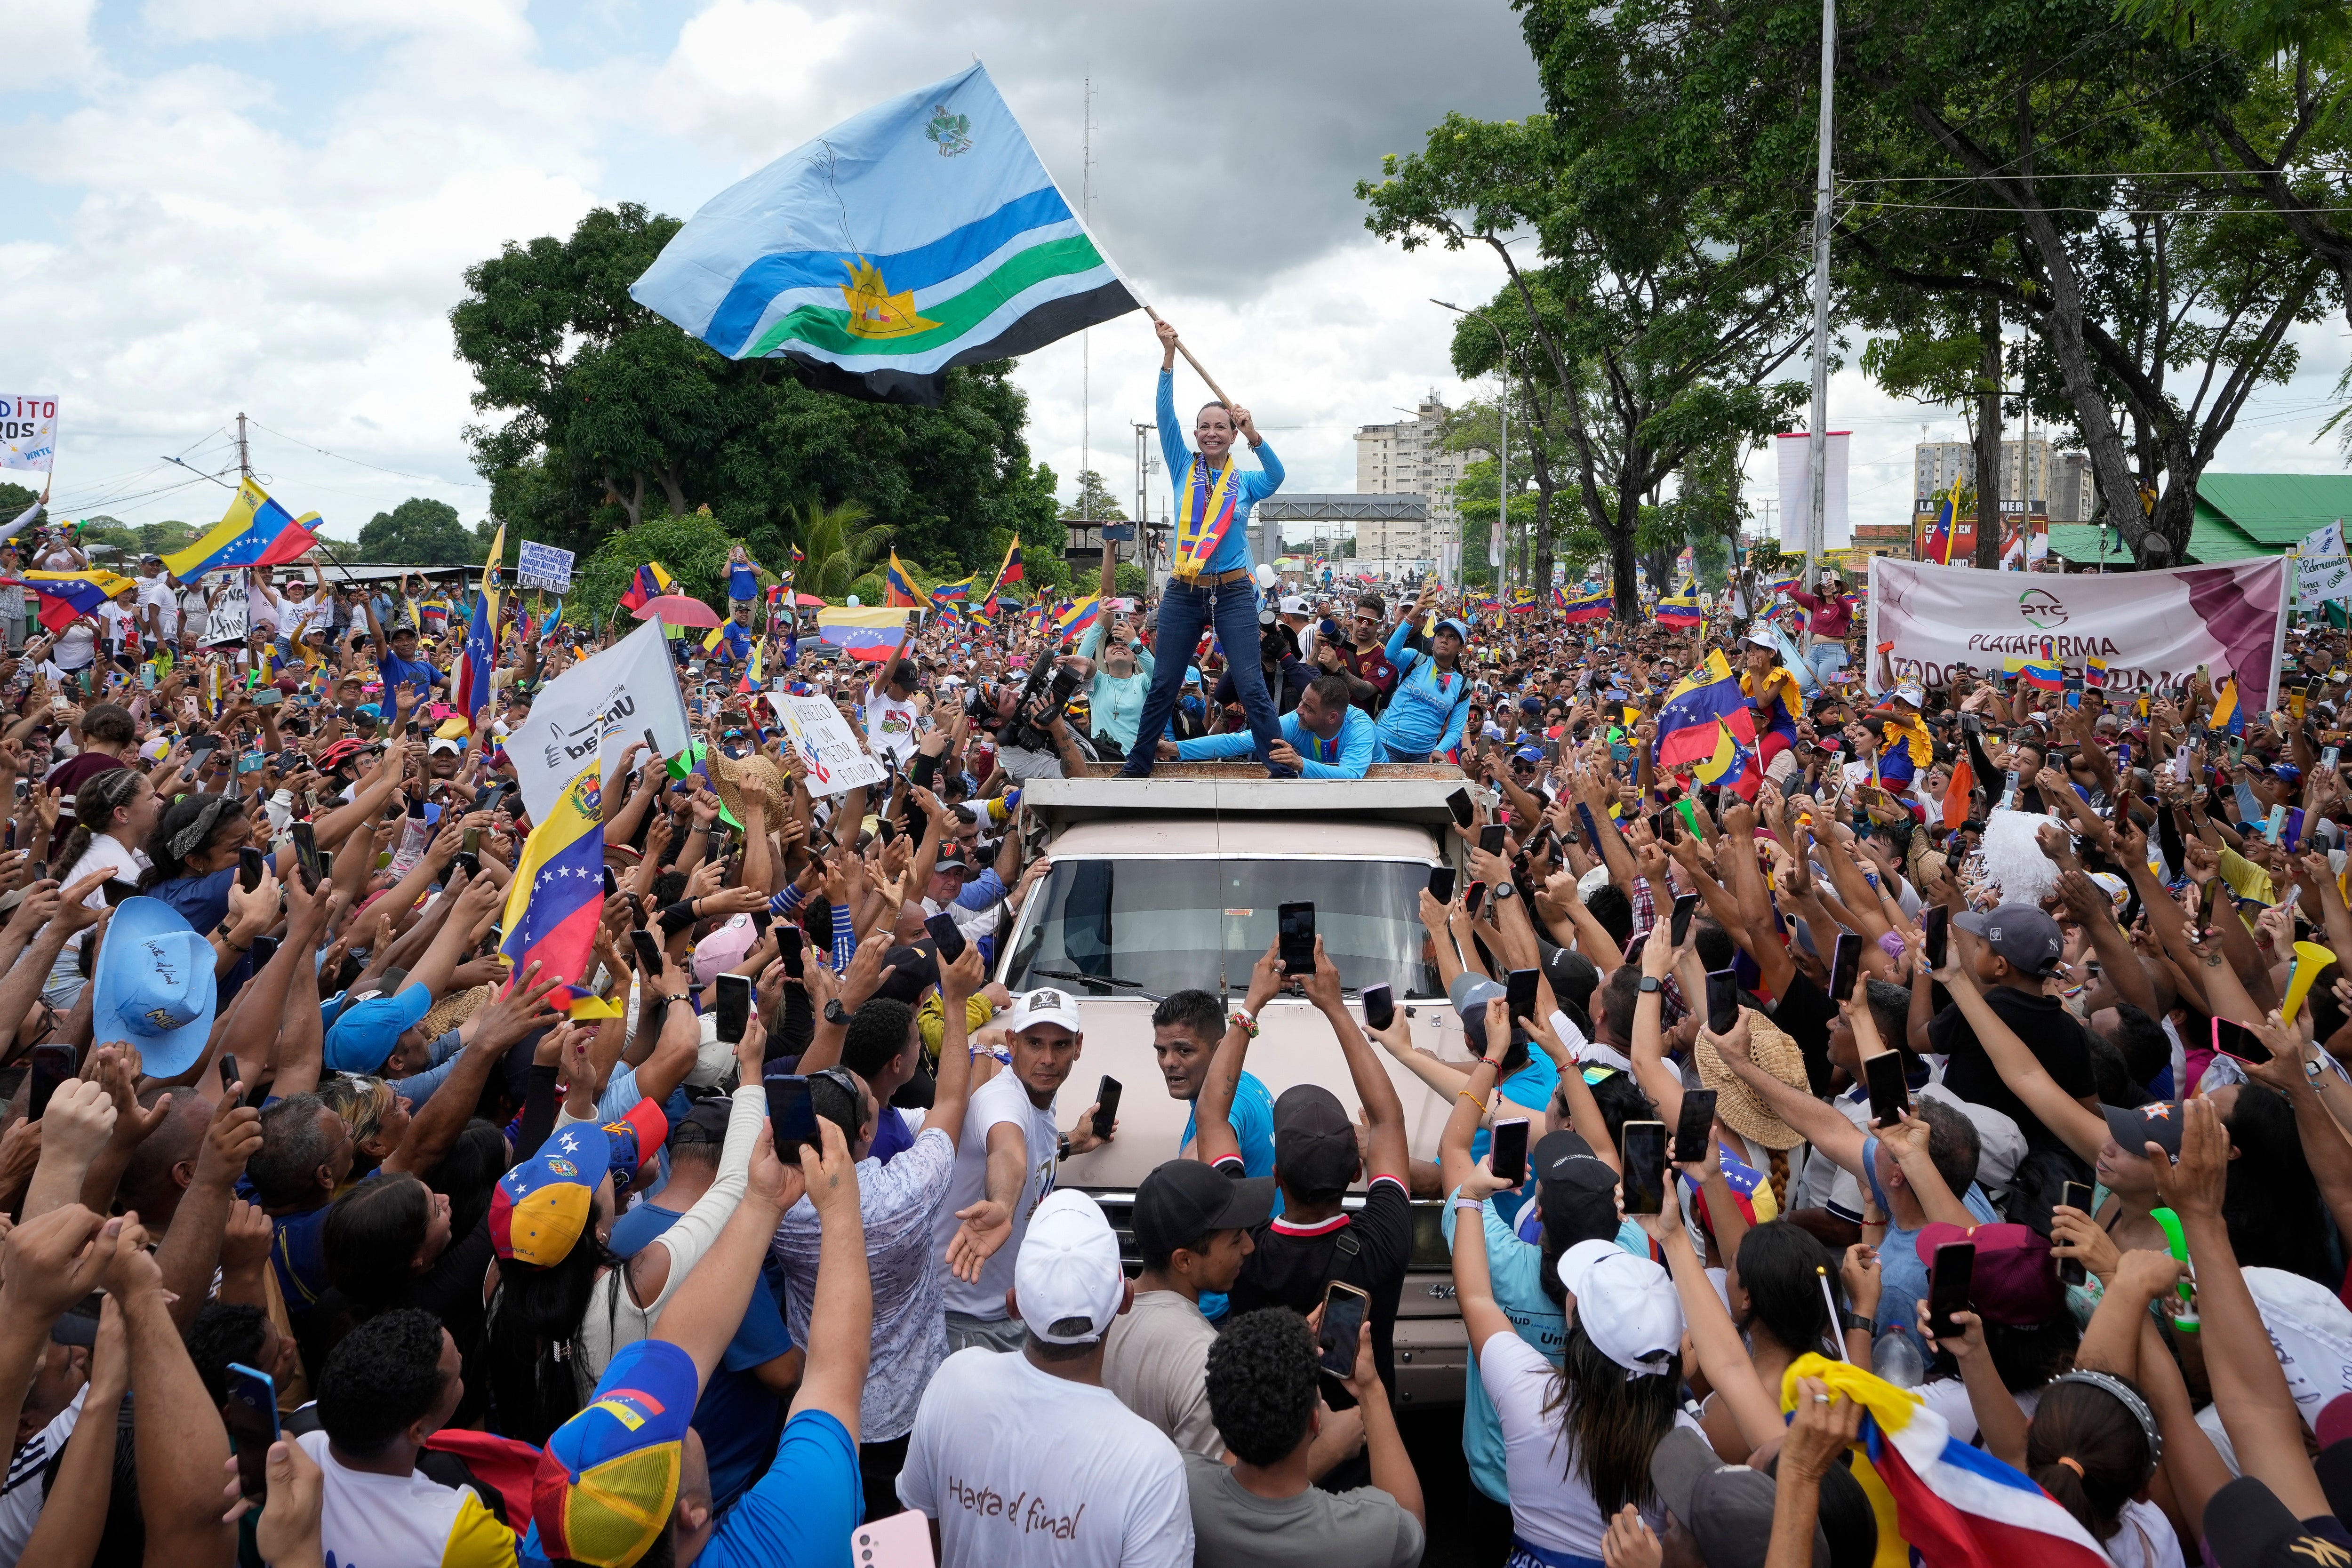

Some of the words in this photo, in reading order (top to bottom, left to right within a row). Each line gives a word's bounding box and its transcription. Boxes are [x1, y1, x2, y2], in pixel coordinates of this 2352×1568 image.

[24, 447, 52, 461] VENTE
[1958, 525, 1971, 534] EN
[2303, 552, 2348, 573] Edmundo
[2327, 568, 2348, 589] GUNE
[2021, 605, 2068, 616] PTC
[1968, 634, 2121, 656] PLATAFORMA
[816, 726, 836, 743] UN
[820, 742, 857, 765] MEJOR
[1008, 1491, 1026, 1526] el
[1025, 1497, 1085, 1540] final
